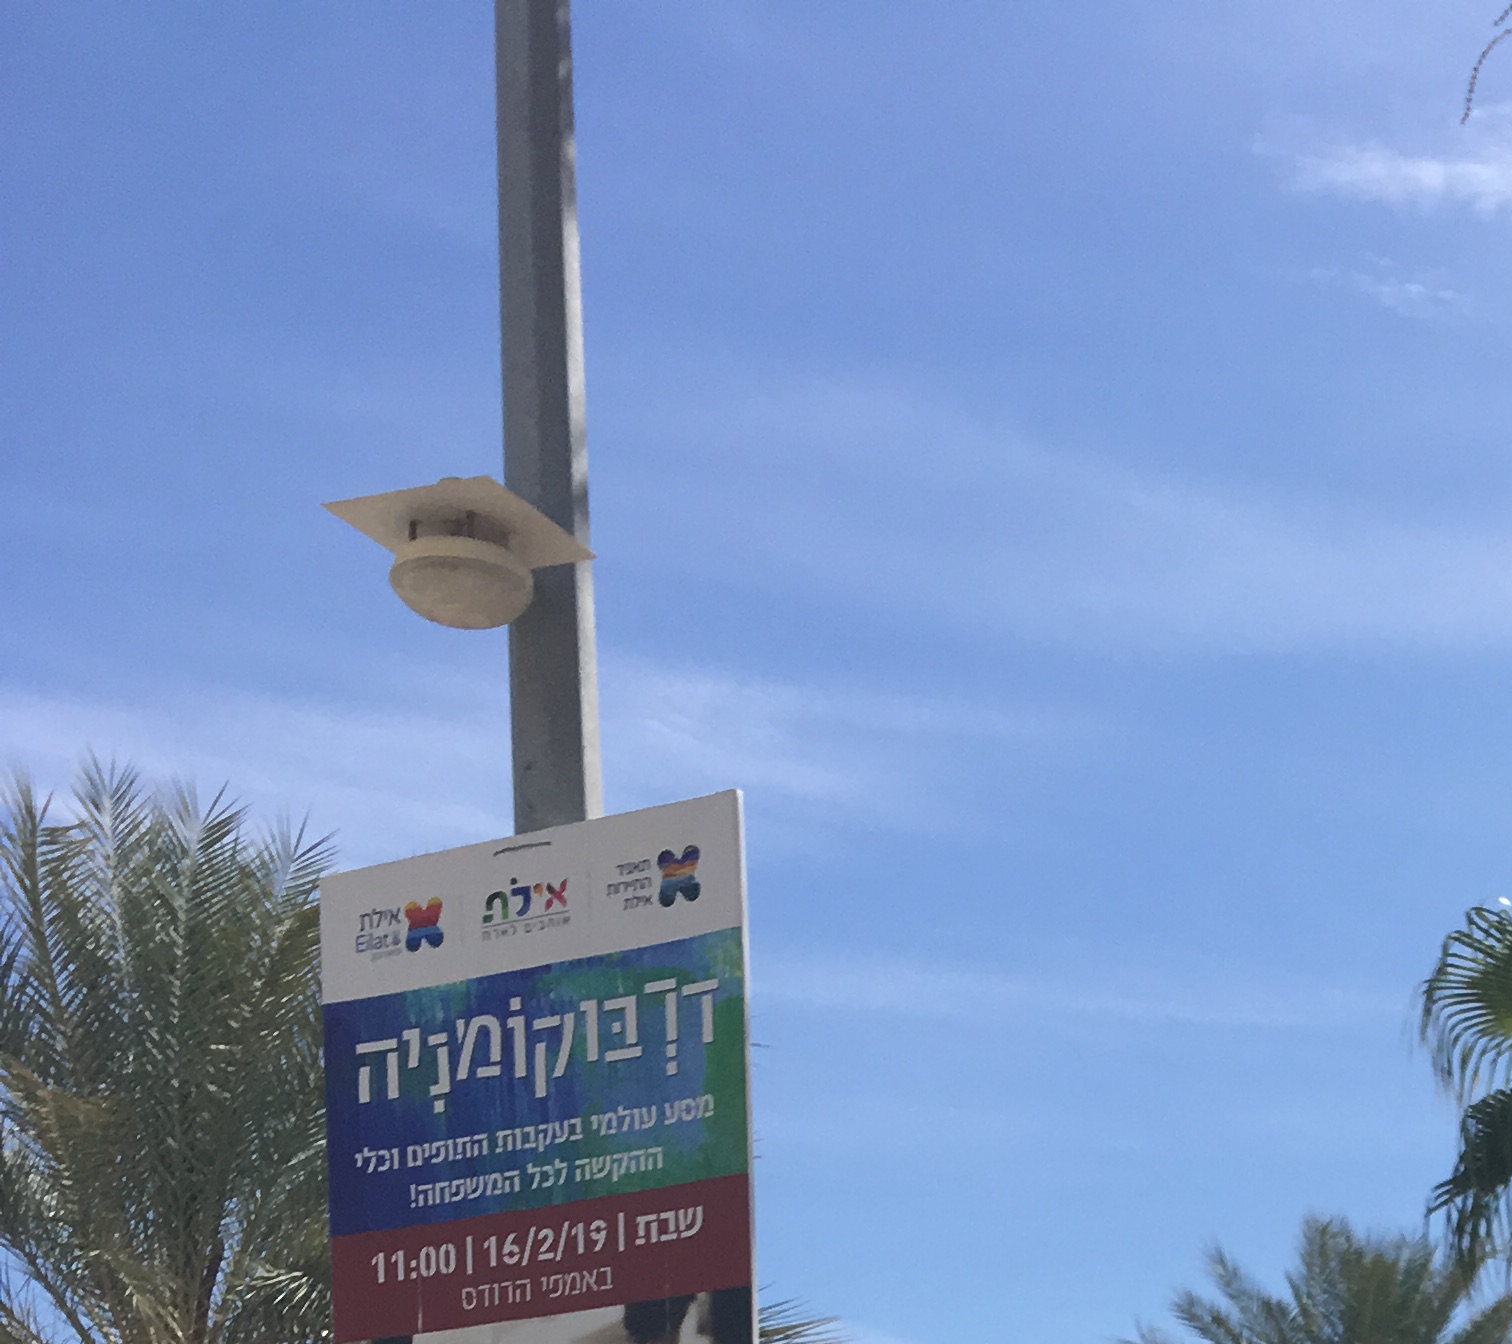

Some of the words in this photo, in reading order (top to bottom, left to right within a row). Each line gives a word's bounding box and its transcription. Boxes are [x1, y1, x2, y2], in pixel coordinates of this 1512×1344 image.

[482, 877, 568, 924] אילת
[359, 906, 402, 932] אילת
[590, 1104, 658, 1137] עולמי
[663, 1093, 715, 1126] מסע
[406, 1132, 489, 1169] התופים
[495, 1117, 584, 1153] בעקבות
[354, 1146, 401, 1175] וכלי
[526, 1158, 569, 1190] לכל
[574, 1146, 664, 1183] ההקשה
[409, 1169, 521, 1209] המשפחה!
[482, 1218, 608, 1268] 16/2/19
[634, 1204, 705, 1247] שבת
[371, 1242, 457, 1285] 11:00
[461, 1279, 532, 1311] הרודס
[541, 1266, 615, 1299] באמפי
